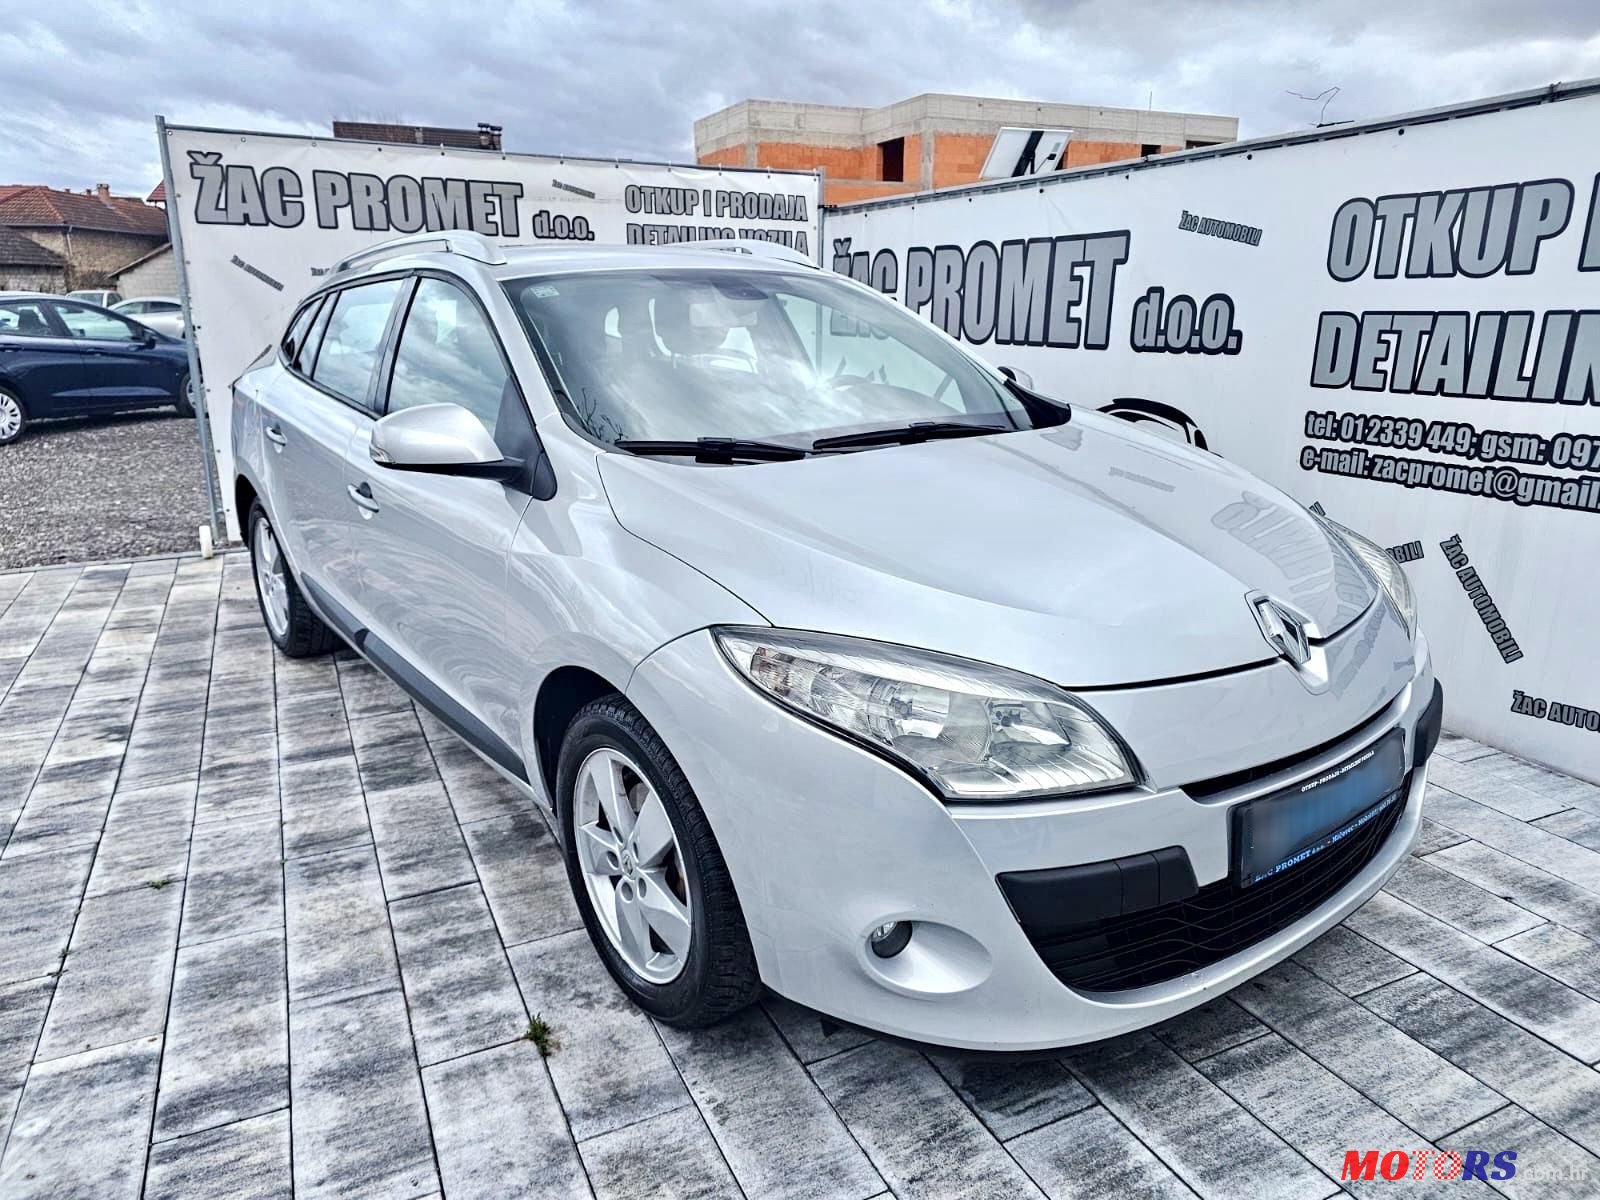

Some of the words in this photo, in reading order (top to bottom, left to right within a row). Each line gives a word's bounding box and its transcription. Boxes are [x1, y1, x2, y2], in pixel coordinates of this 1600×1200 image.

[187, 150, 304, 228] ŽAC
[312, 169, 523, 237] PROMET
[532, 210, 595, 240] d.o.o.
[625, 184, 699, 216] OTKUP
[703, 189, 712, 217] I
[716, 190, 808, 222] PRODAJA
[1178, 210, 1200, 232] ŽAC
[1197, 217, 1263, 247] AUTOMOBILI
[1327, 178, 1575, 282] OTKUP
[904, 230, 1130, 351] PROMET
[1130, 286, 1243, 355] d.o.o.
[1300, 446, 1371, 480] e-mail:
[1304, 410, 1340, 441] tel:
[1479, 430, 1550, 465] gsm:
[1440, 533, 1469, 570] ŽAC
[1456, 565, 1524, 664] AUTOMOBILI
[1511, 689, 1547, 718] ŽAC
[1547, 701, 1600, 733] AUTO
